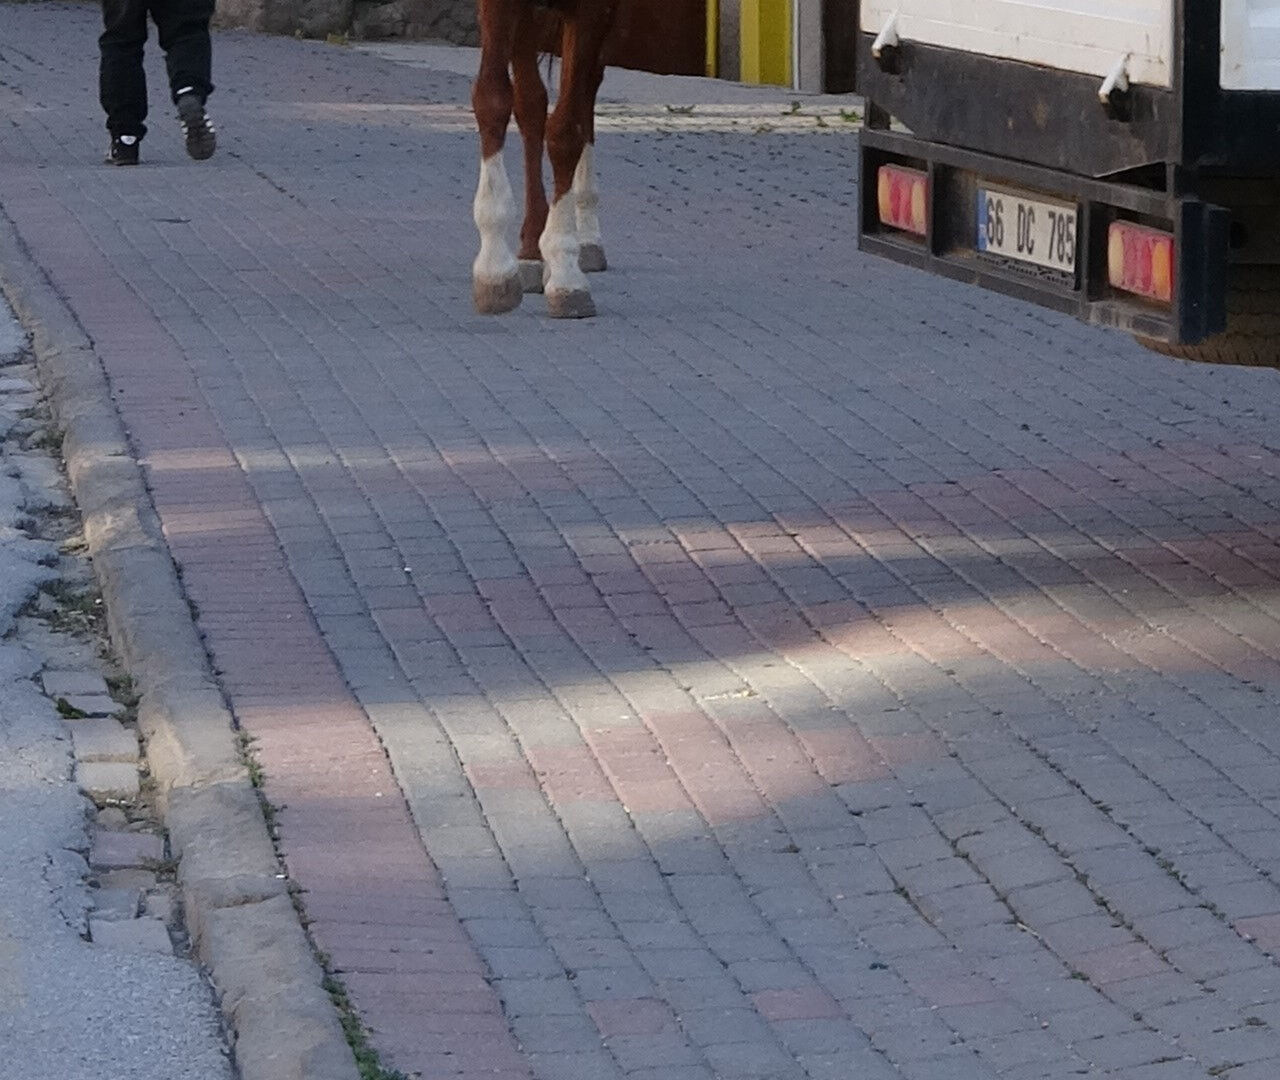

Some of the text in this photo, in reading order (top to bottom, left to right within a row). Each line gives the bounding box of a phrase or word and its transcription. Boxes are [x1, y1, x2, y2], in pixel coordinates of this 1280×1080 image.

[987, 197, 1075, 265] 66 DC 785
